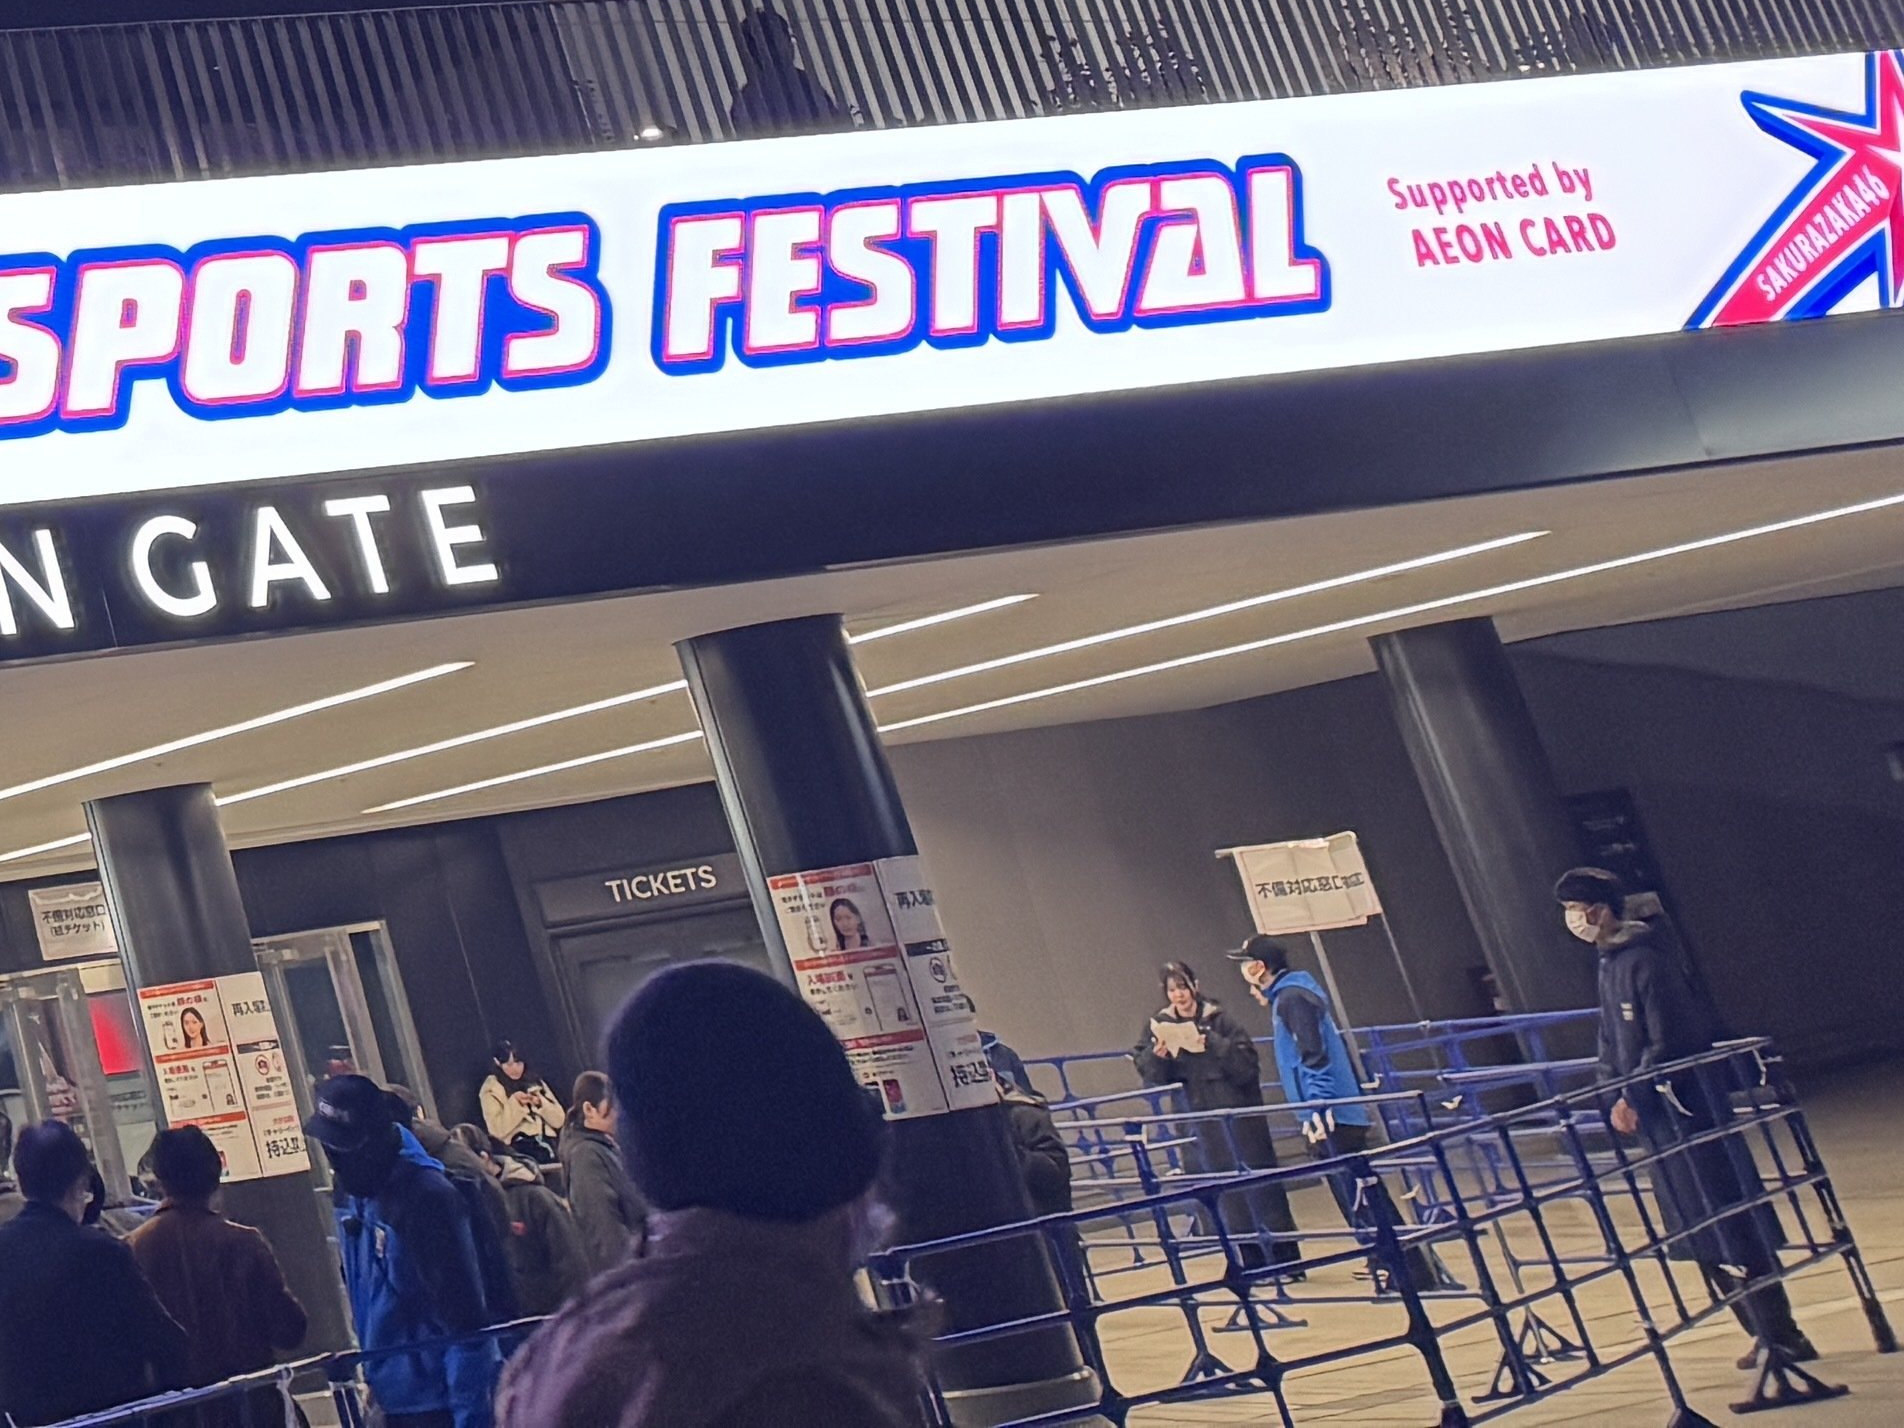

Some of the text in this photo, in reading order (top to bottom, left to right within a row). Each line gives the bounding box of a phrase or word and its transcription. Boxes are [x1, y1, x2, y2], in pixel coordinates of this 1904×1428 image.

[1386, 161, 1593, 215] Supported by
[1756, 164, 1890, 302] SAKURAZAKA46
[652, 154, 1331, 376] FESTIVAL
[1411, 213, 1617, 267] AEON CARD
[132, 485, 499, 617] GATE
[604, 865, 718, 904] TICKETS
